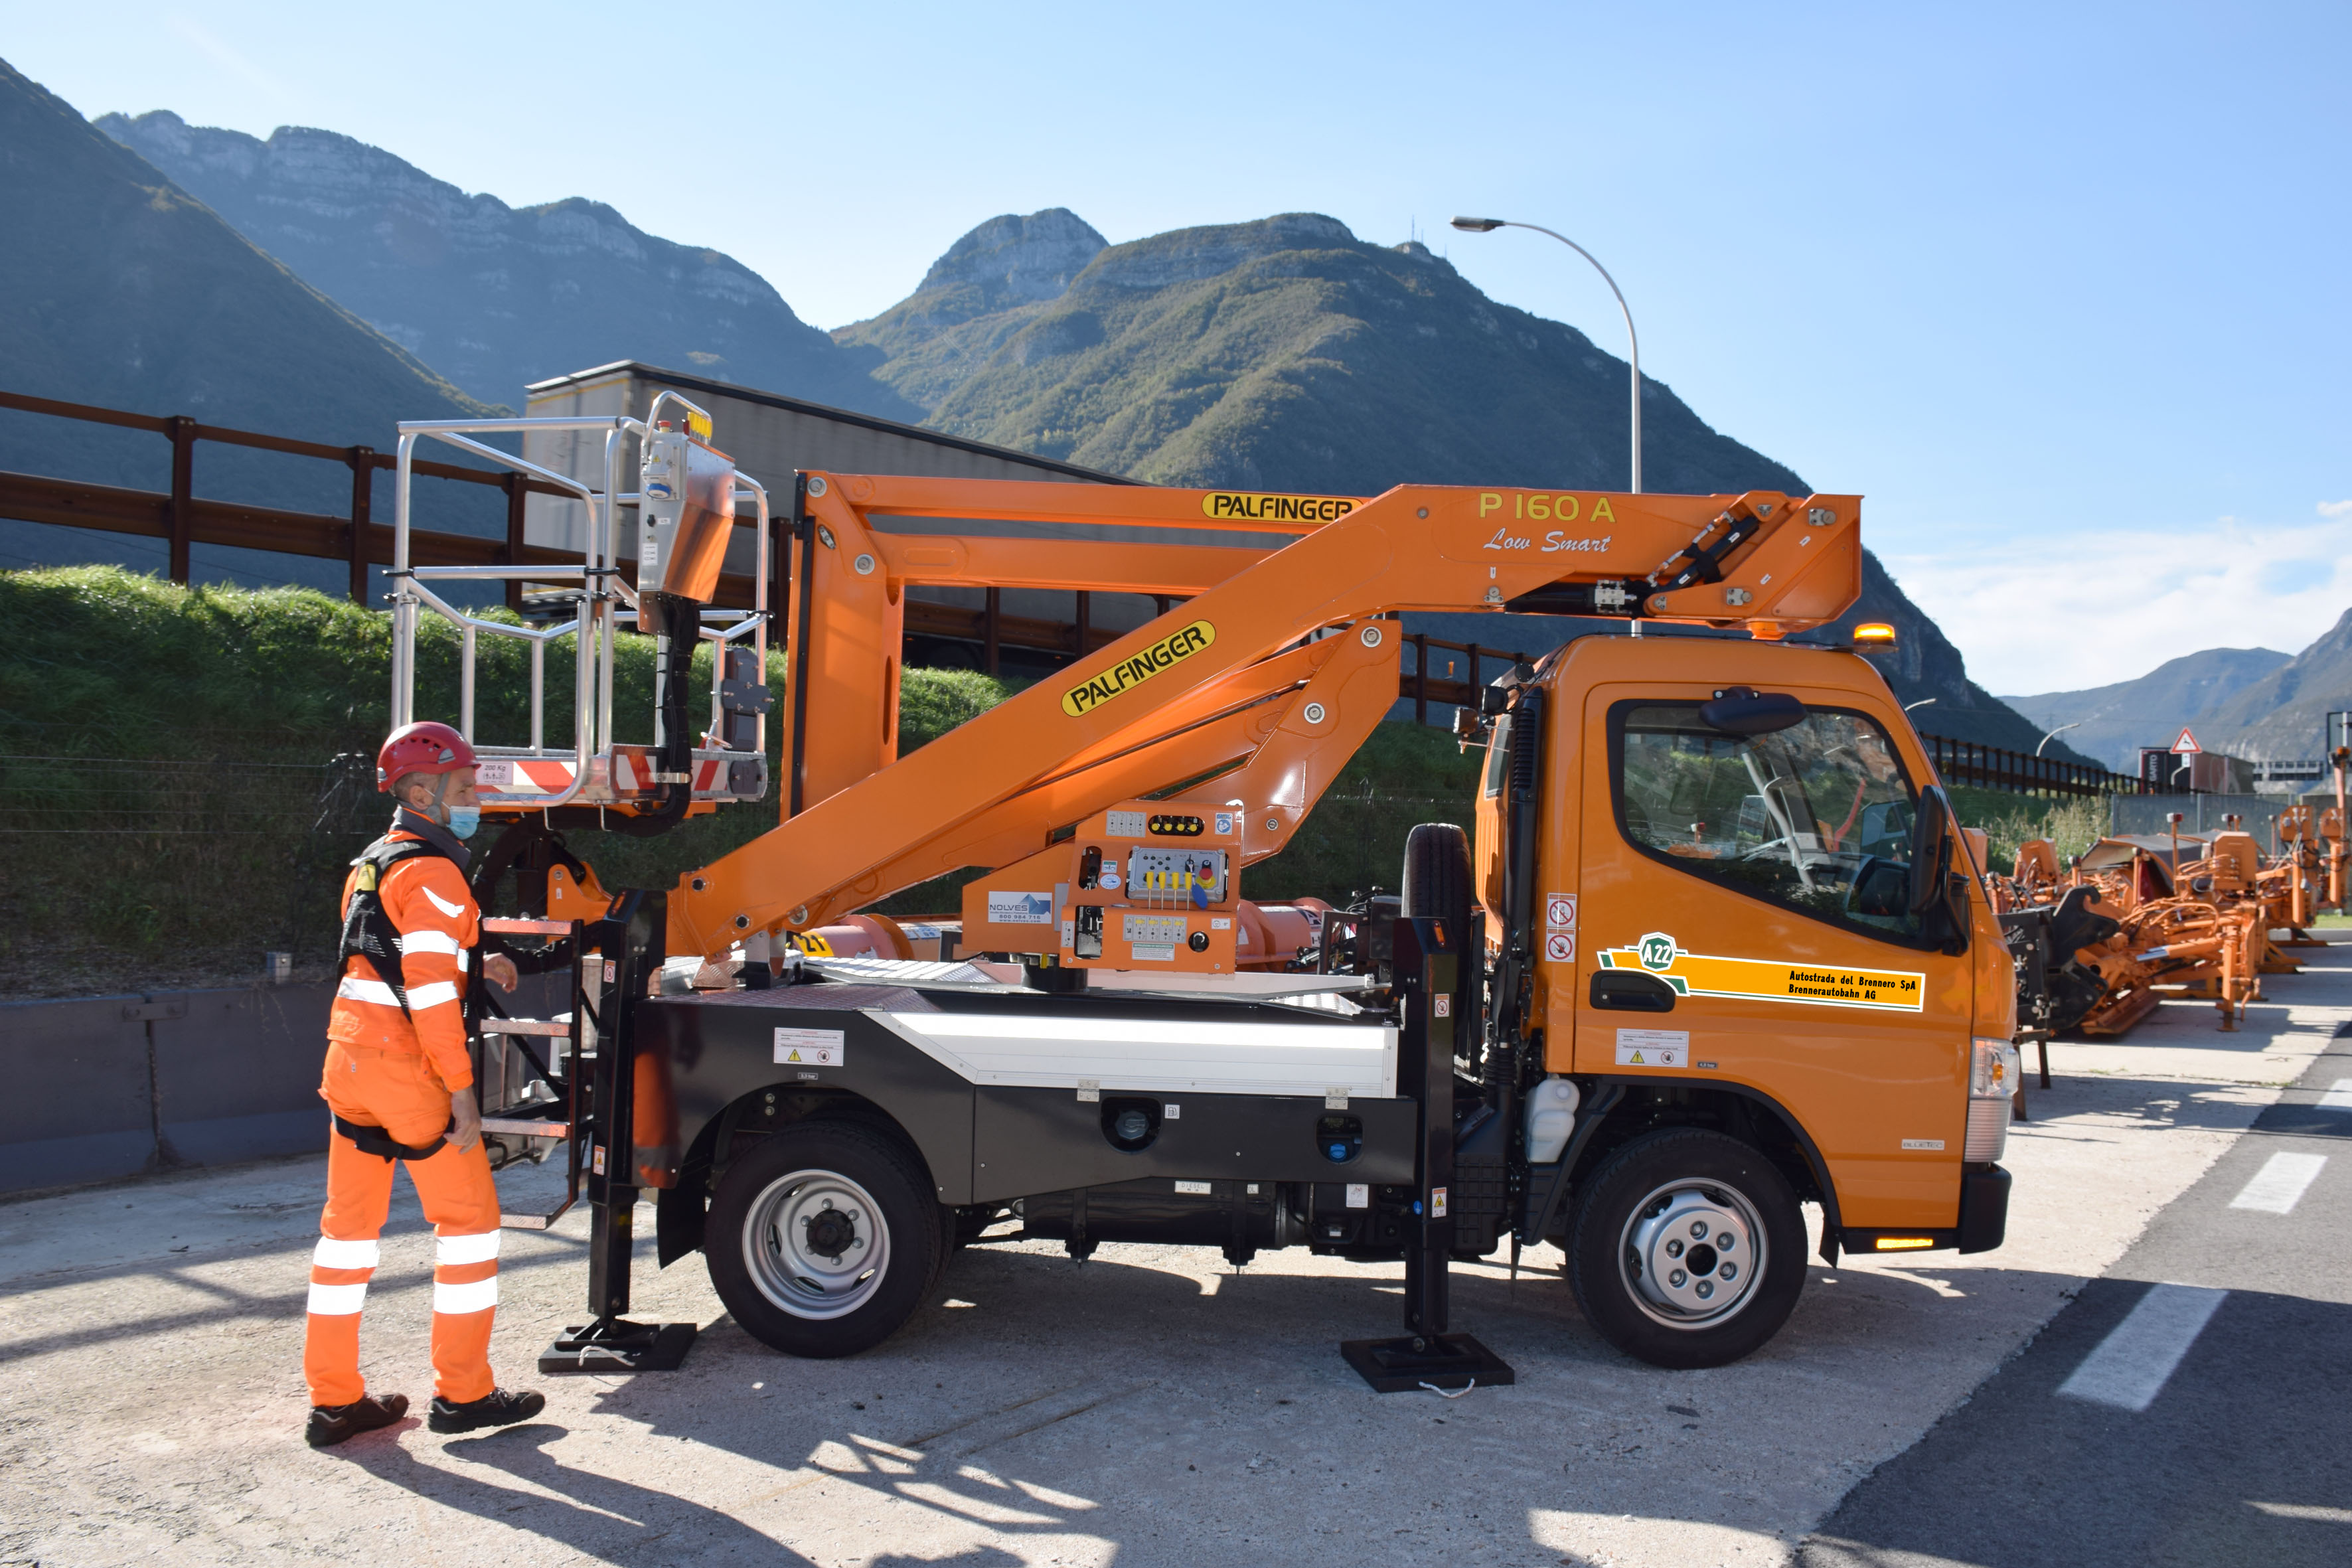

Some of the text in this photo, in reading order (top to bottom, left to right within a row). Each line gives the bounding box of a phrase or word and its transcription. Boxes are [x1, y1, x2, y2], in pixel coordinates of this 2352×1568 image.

[1214, 495, 1353, 521] PALFINGER
[1480, 493, 1616, 523] P 160 A
[1483, 527, 1612, 552] Low Smart
[1070, 626, 1208, 712] PALFINGER
[1788, 984, 1876, 1000] Brennerautobahn AG
[1789, 971, 1917, 992] Autostrada del Brennero SpA
